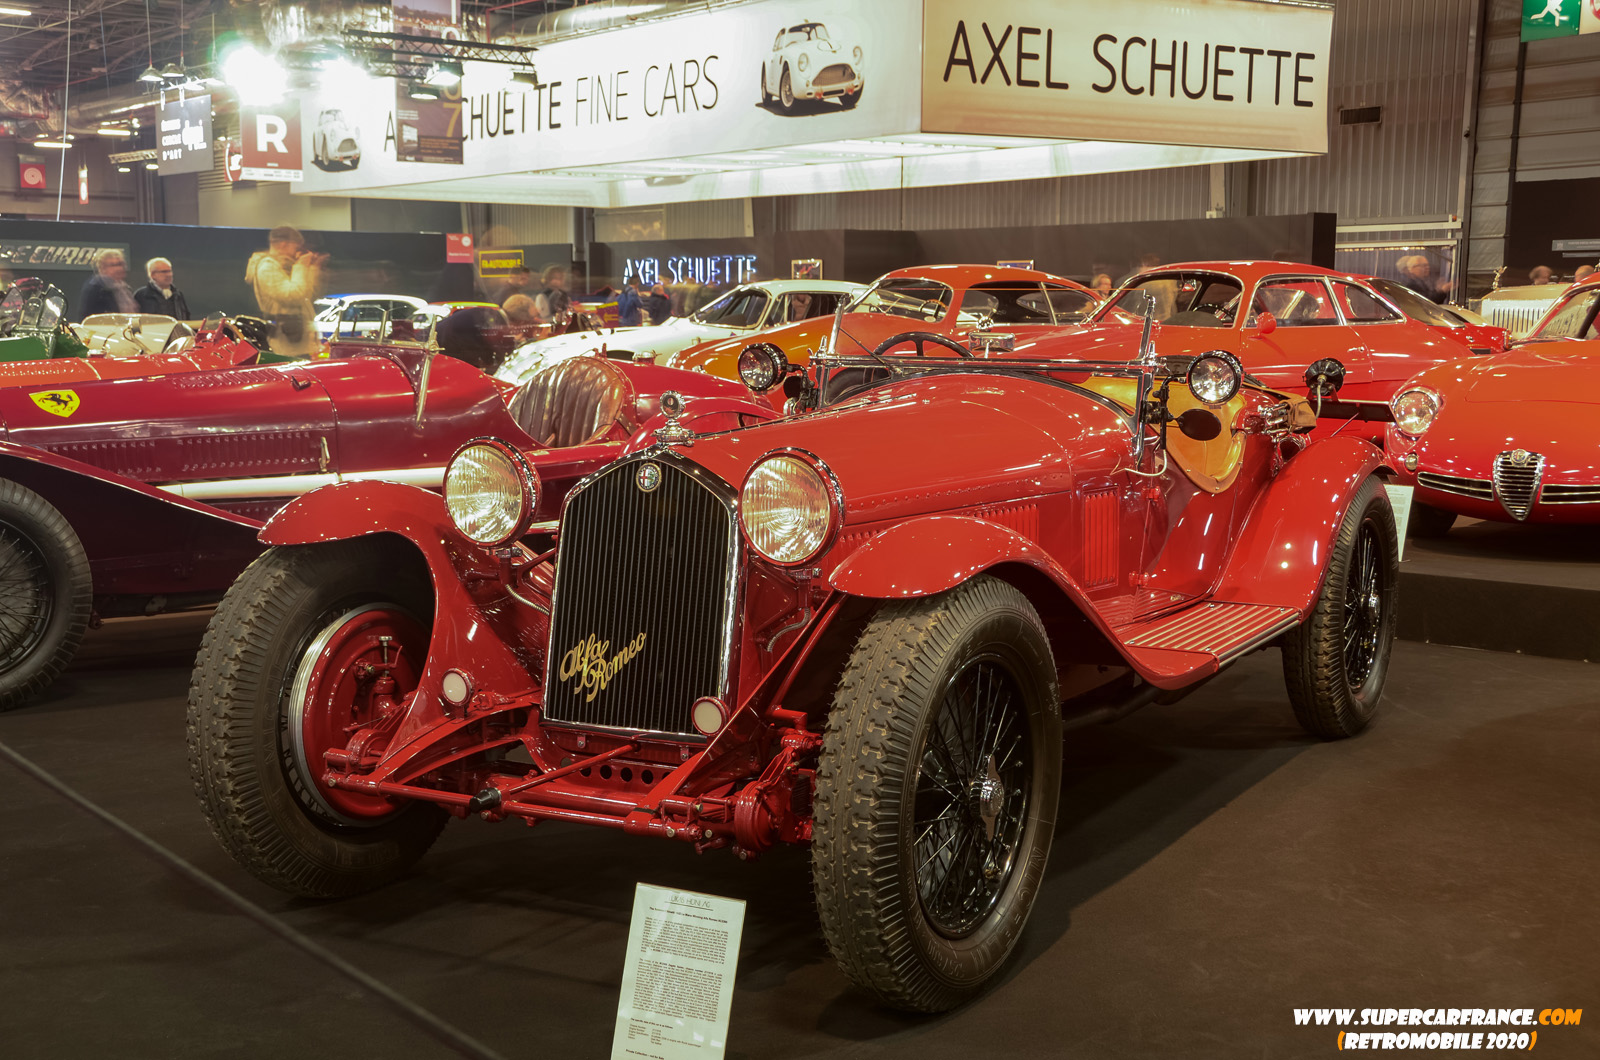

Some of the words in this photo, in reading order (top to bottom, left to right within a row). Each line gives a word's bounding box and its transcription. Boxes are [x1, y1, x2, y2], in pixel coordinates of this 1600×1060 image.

[575, 70, 630, 127] FINE
[643, 55, 719, 117] CARS
[943, 20, 1069, 90] AXEL
[1091, 33, 1316, 108] SCHUETTE
[256, 114, 289, 153] R
[622, 257, 661, 287] AXEL
[667, 254, 757, 287] SCHUETTE
[559, 633, 610, 694] Alfa
[585, 632, 647, 703] Romeo
